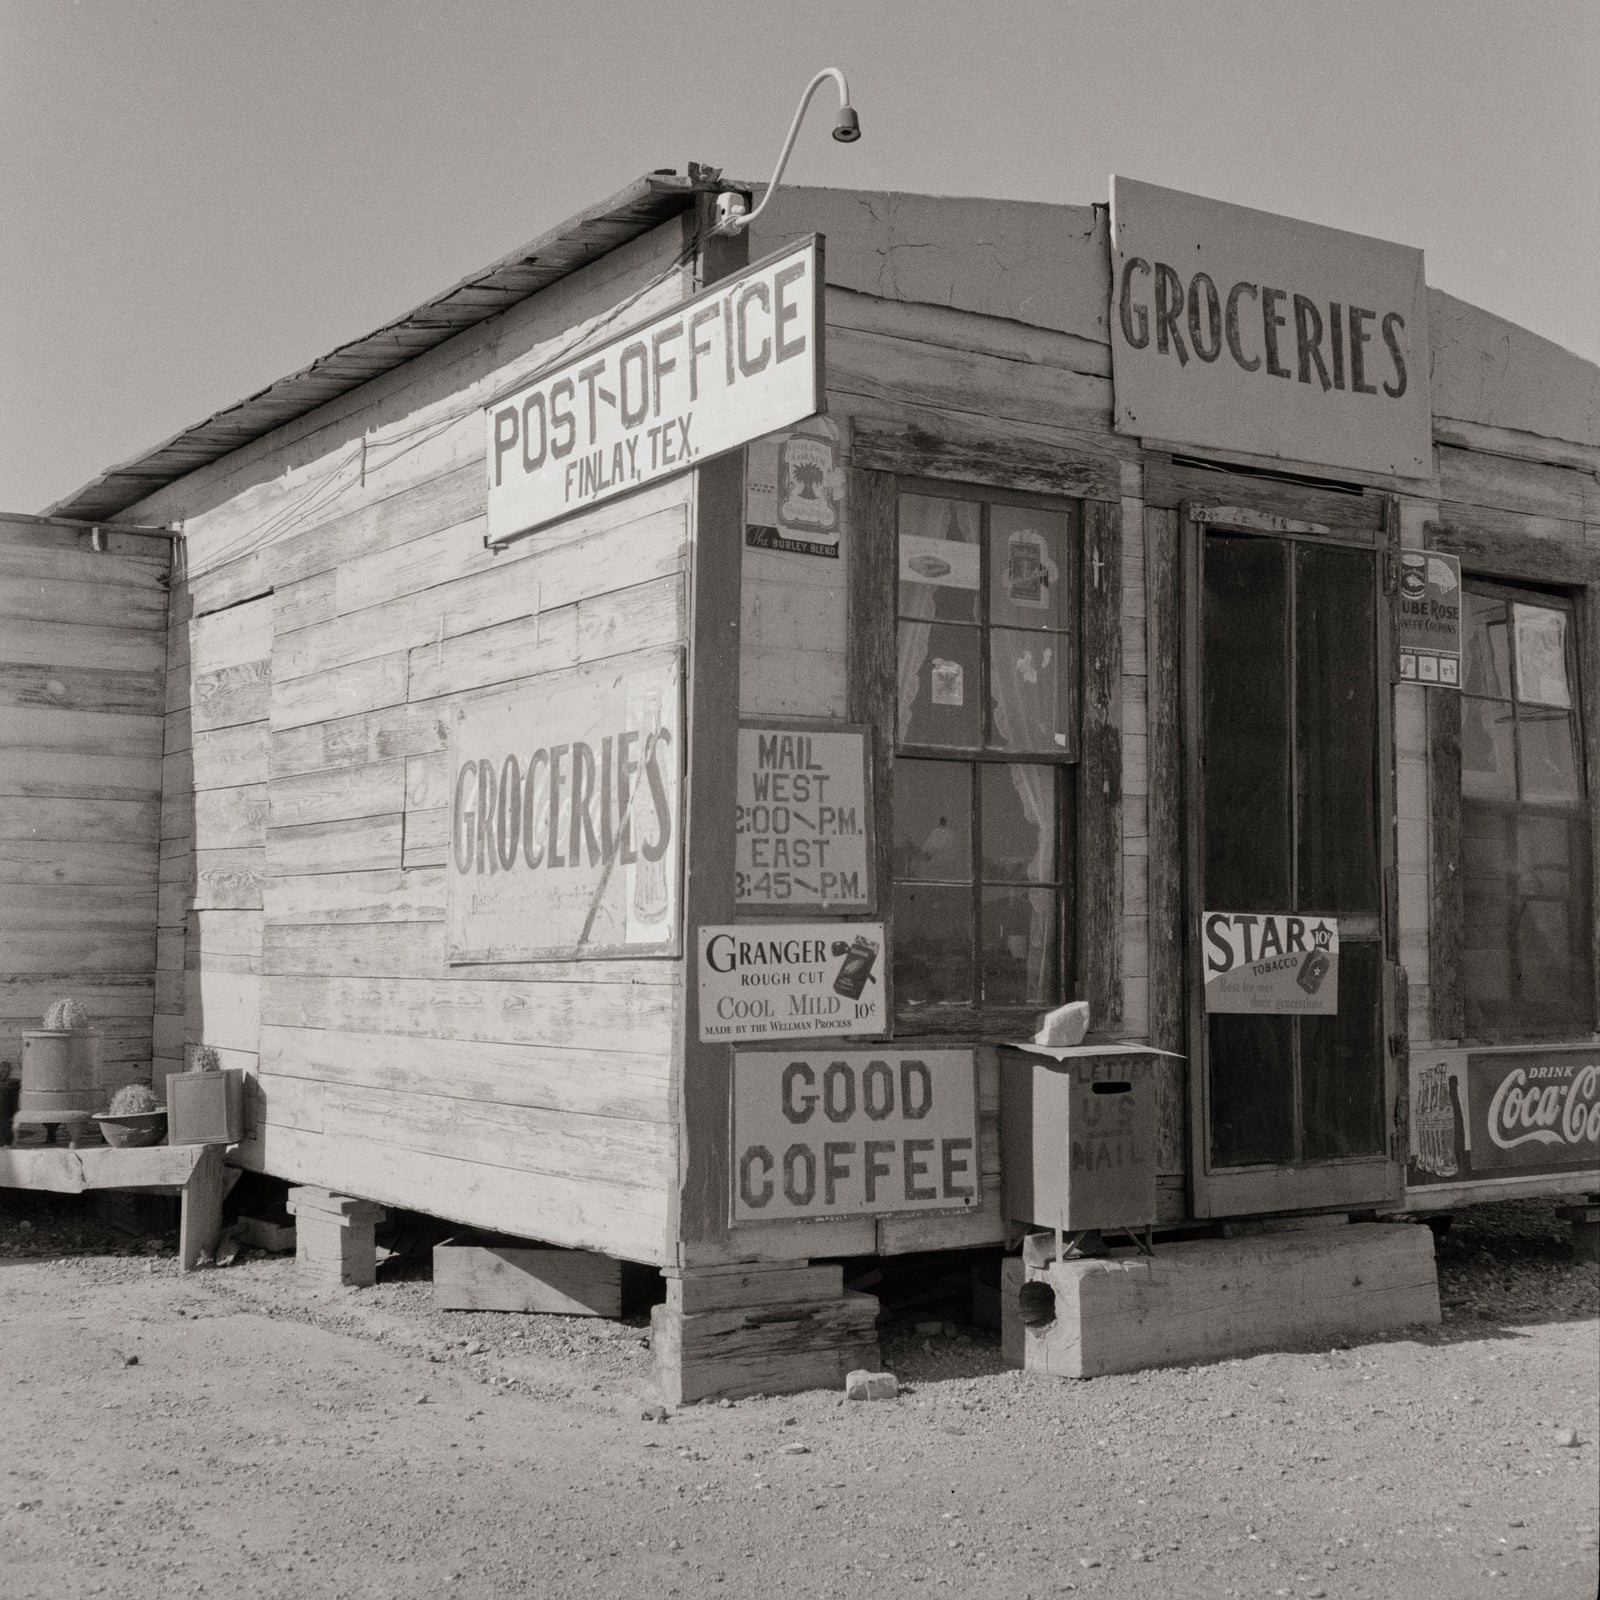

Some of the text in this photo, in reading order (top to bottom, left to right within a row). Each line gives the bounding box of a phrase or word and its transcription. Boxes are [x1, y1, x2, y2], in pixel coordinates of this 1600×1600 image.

[1119, 256, 1408, 399] GROCERIES
[646, 411, 700, 471] TEX.
[746, 525, 836, 556] The BURLEY BLEND
[1401, 598, 1459, 621] UBE ROSE
[758, 734, 823, 770] MAIL
[453, 726, 672, 876] GROCERIES
[752, 772, 830, 803] WEST
[751, 838, 830, 868] EAST
[705, 933, 827, 973] GRANGER
[1205, 913, 1308, 973] STAR
[741, 972, 791, 986] ROUGH
[798, 971, 825, 985] CUT
[1252, 957, 1298, 977] TOBACCO
[716, 993, 841, 1020] COOL MILD
[705, 1018, 852, 1035] MADE BY THE WELLMAN PROCESS
[1076, 1059, 1156, 1084] LETTER
[1529, 1066, 1575, 1079] DRINK
[781, 1059, 933, 1124] GOOD
[1073, 1141, 1146, 1172] MAIL
[740, 1137, 974, 1209] COFFEE
